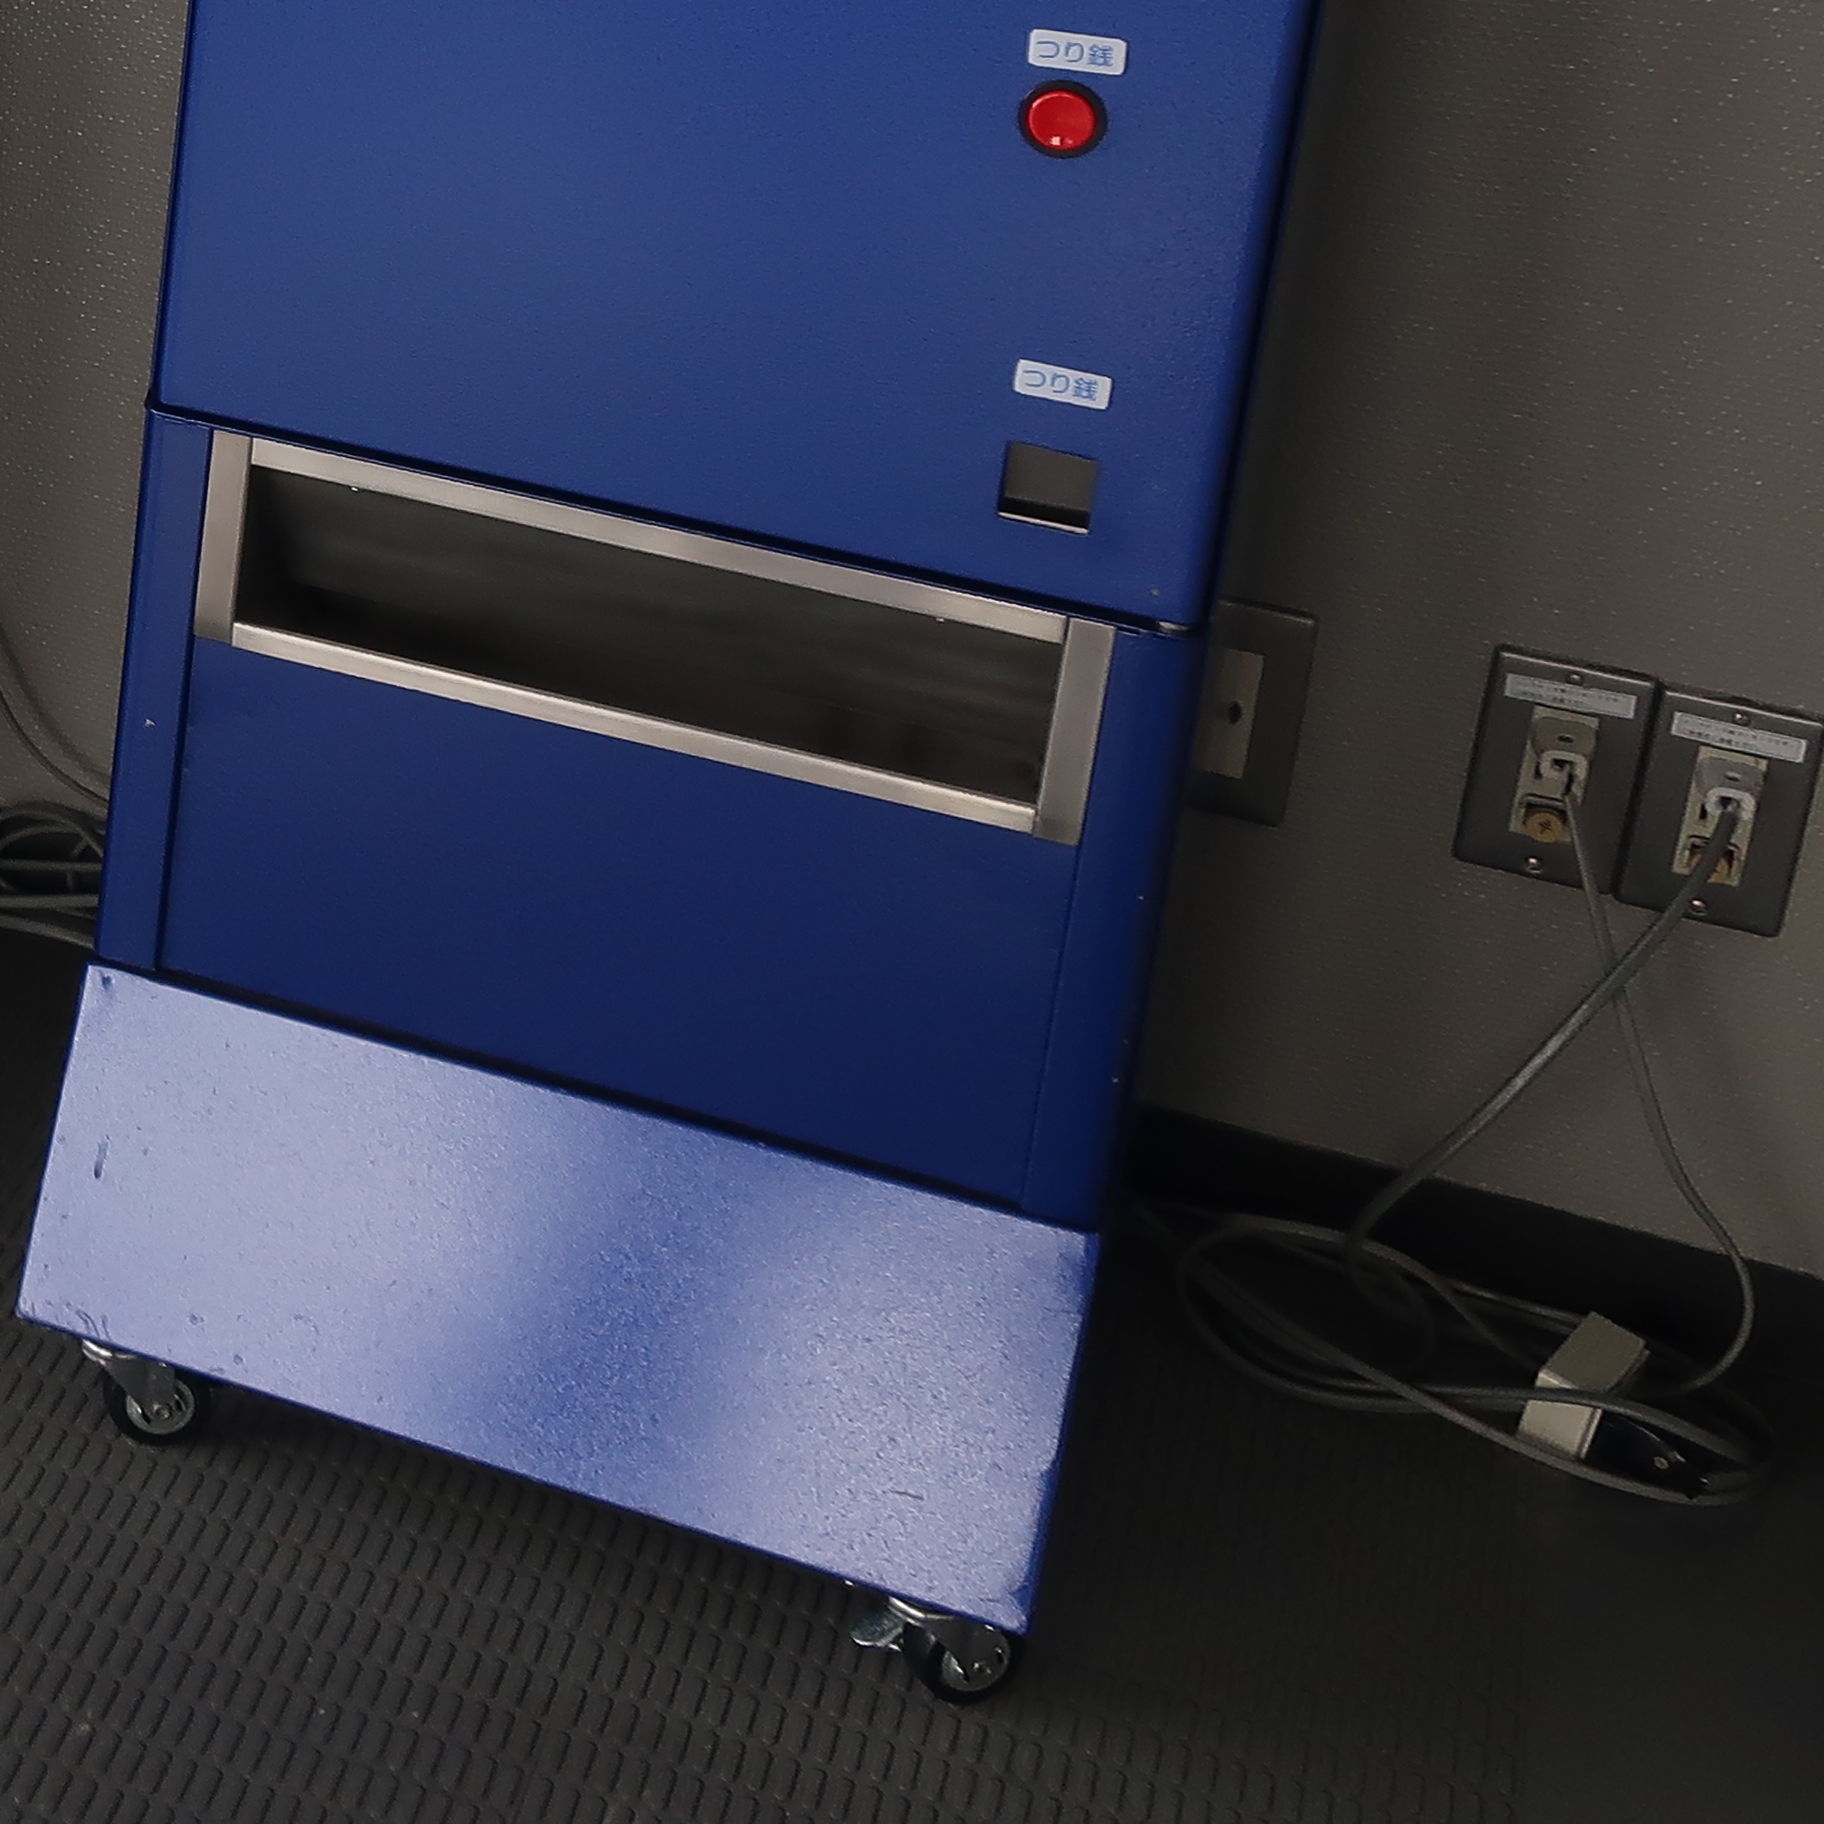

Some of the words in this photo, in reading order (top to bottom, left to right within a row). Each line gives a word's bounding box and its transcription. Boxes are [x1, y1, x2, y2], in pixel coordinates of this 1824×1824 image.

[1036, 40, 1115, 68] つり銭
[1023, 369, 1100, 402] つり銭
